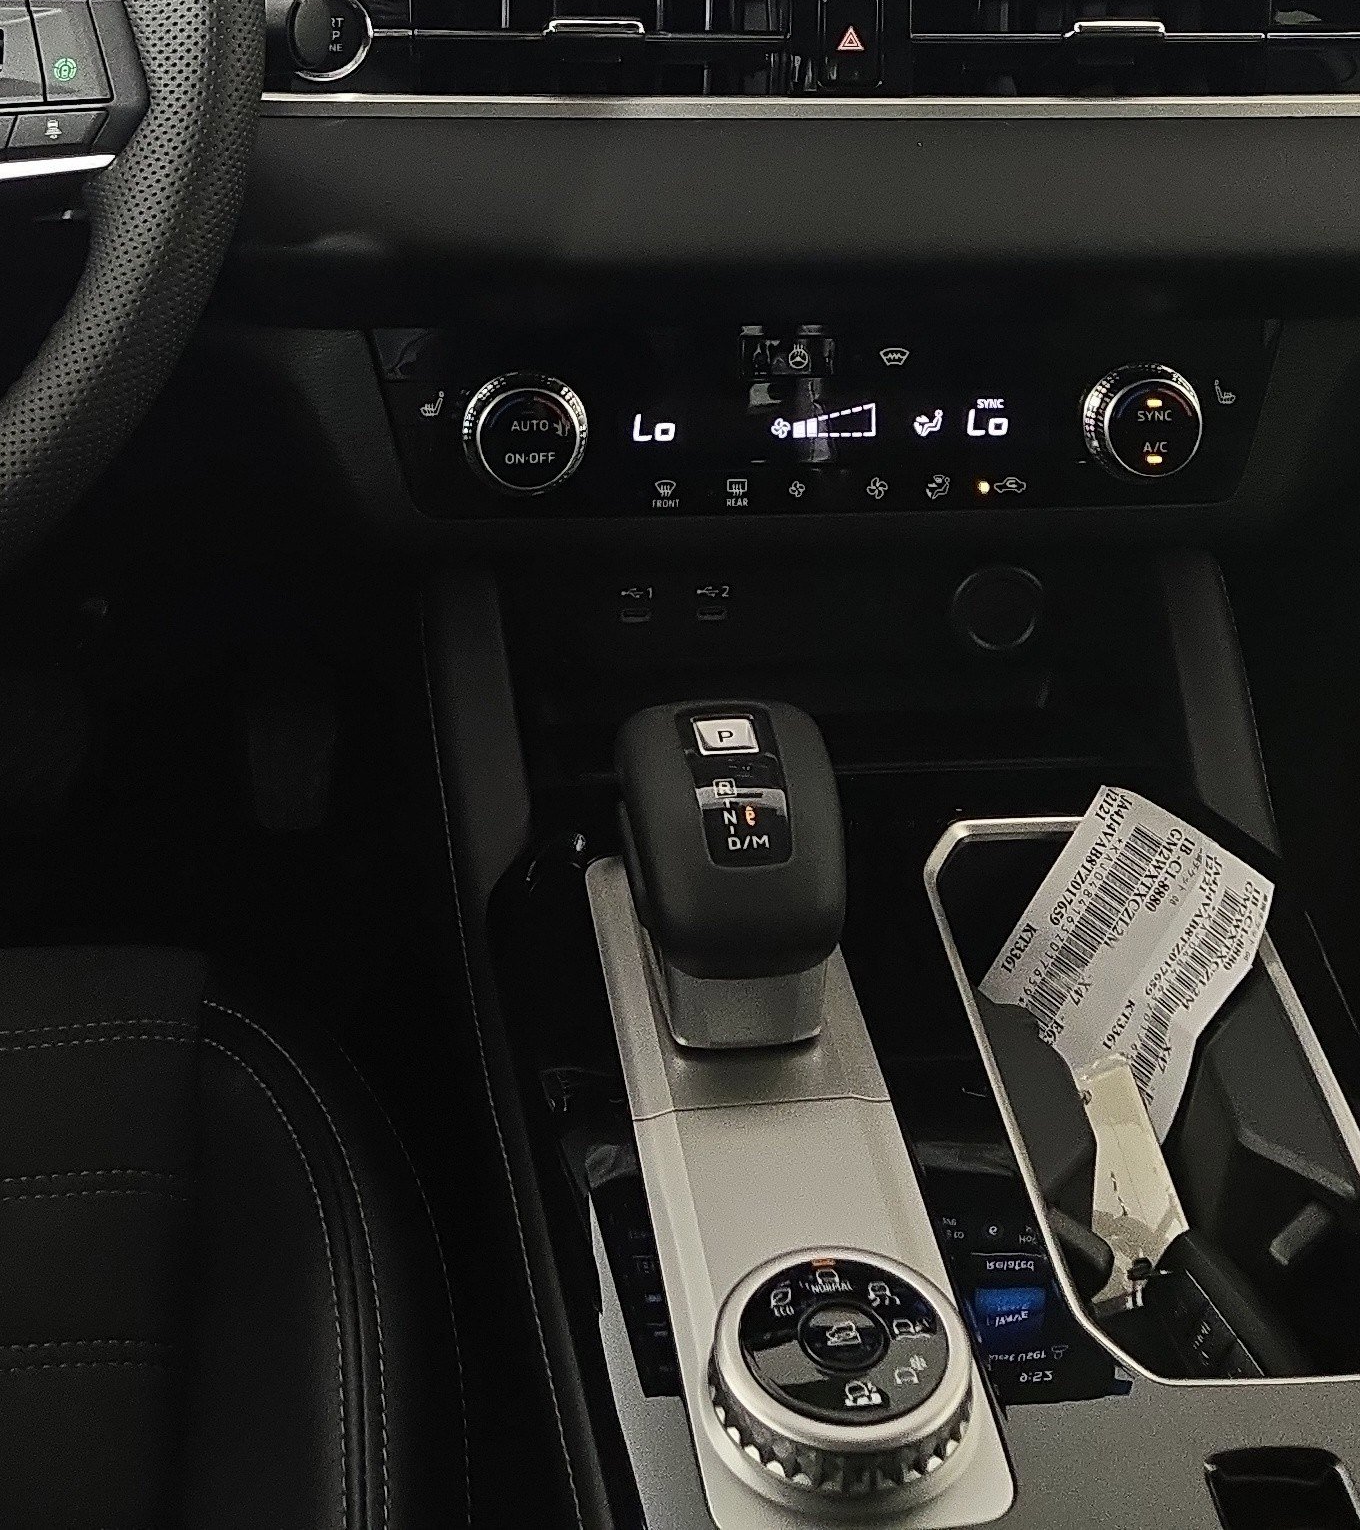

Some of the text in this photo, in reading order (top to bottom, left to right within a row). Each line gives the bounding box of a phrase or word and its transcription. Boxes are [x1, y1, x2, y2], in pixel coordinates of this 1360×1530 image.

[977, 398, 1004, 409] SYNC
[1136, 410, 1173, 423] SYNC
[511, 420, 549, 432] AUTO
[1143, 441, 1168, 454] A/C
[652, 498, 680, 509] FRONT
[726, 497, 749, 508] REAR
[717, 729, 734, 743] P
[723, 810, 738, 825] N
[728, 834, 770, 851] D/M
[1045, 793, 1134, 928] JA4J4VAB8TZ017659
[999, 922, 1037, 973] KT3361
